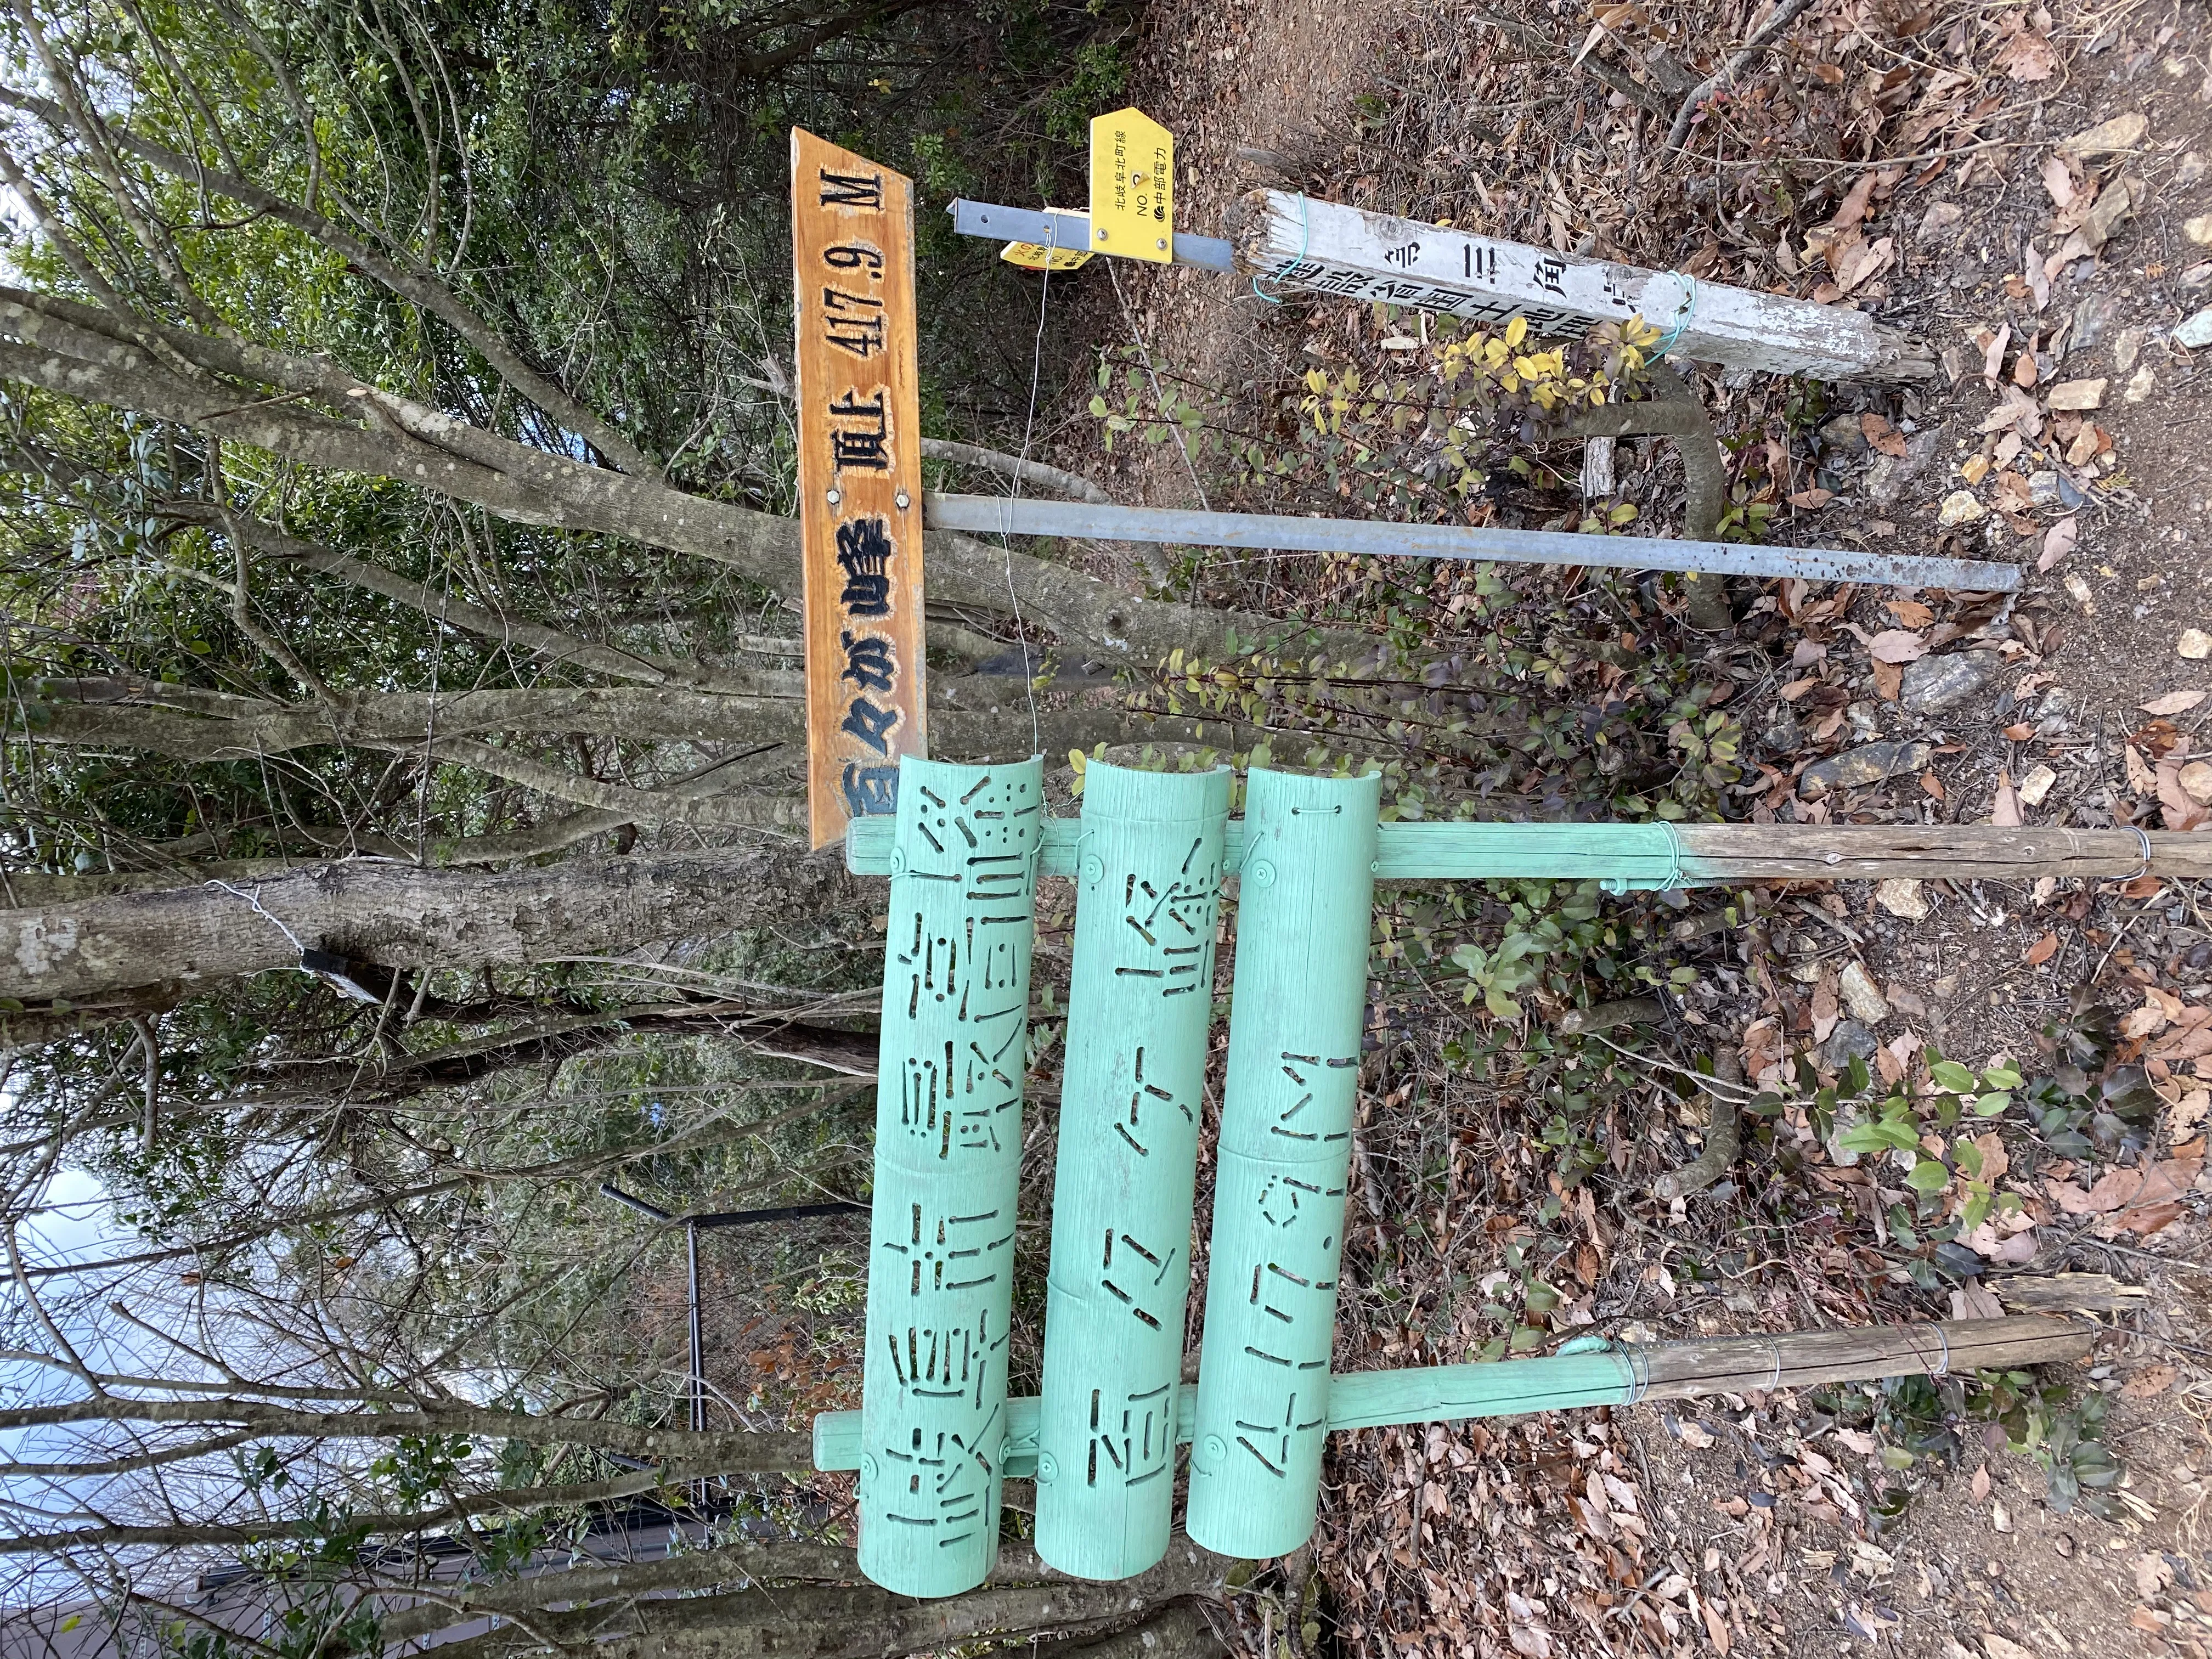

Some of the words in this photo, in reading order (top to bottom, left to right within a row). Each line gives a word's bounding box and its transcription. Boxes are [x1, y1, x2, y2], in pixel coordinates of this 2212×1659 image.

[1114, 130, 1126, 211] 北岐阜北町線
[1137, 193, 1148, 217] NO.
[1153, 147, 1166, 205] 中部電力
[828, 390, 888, 472] 頂上
[882, 777, 1039, 1548] 岐阜市最高峰
